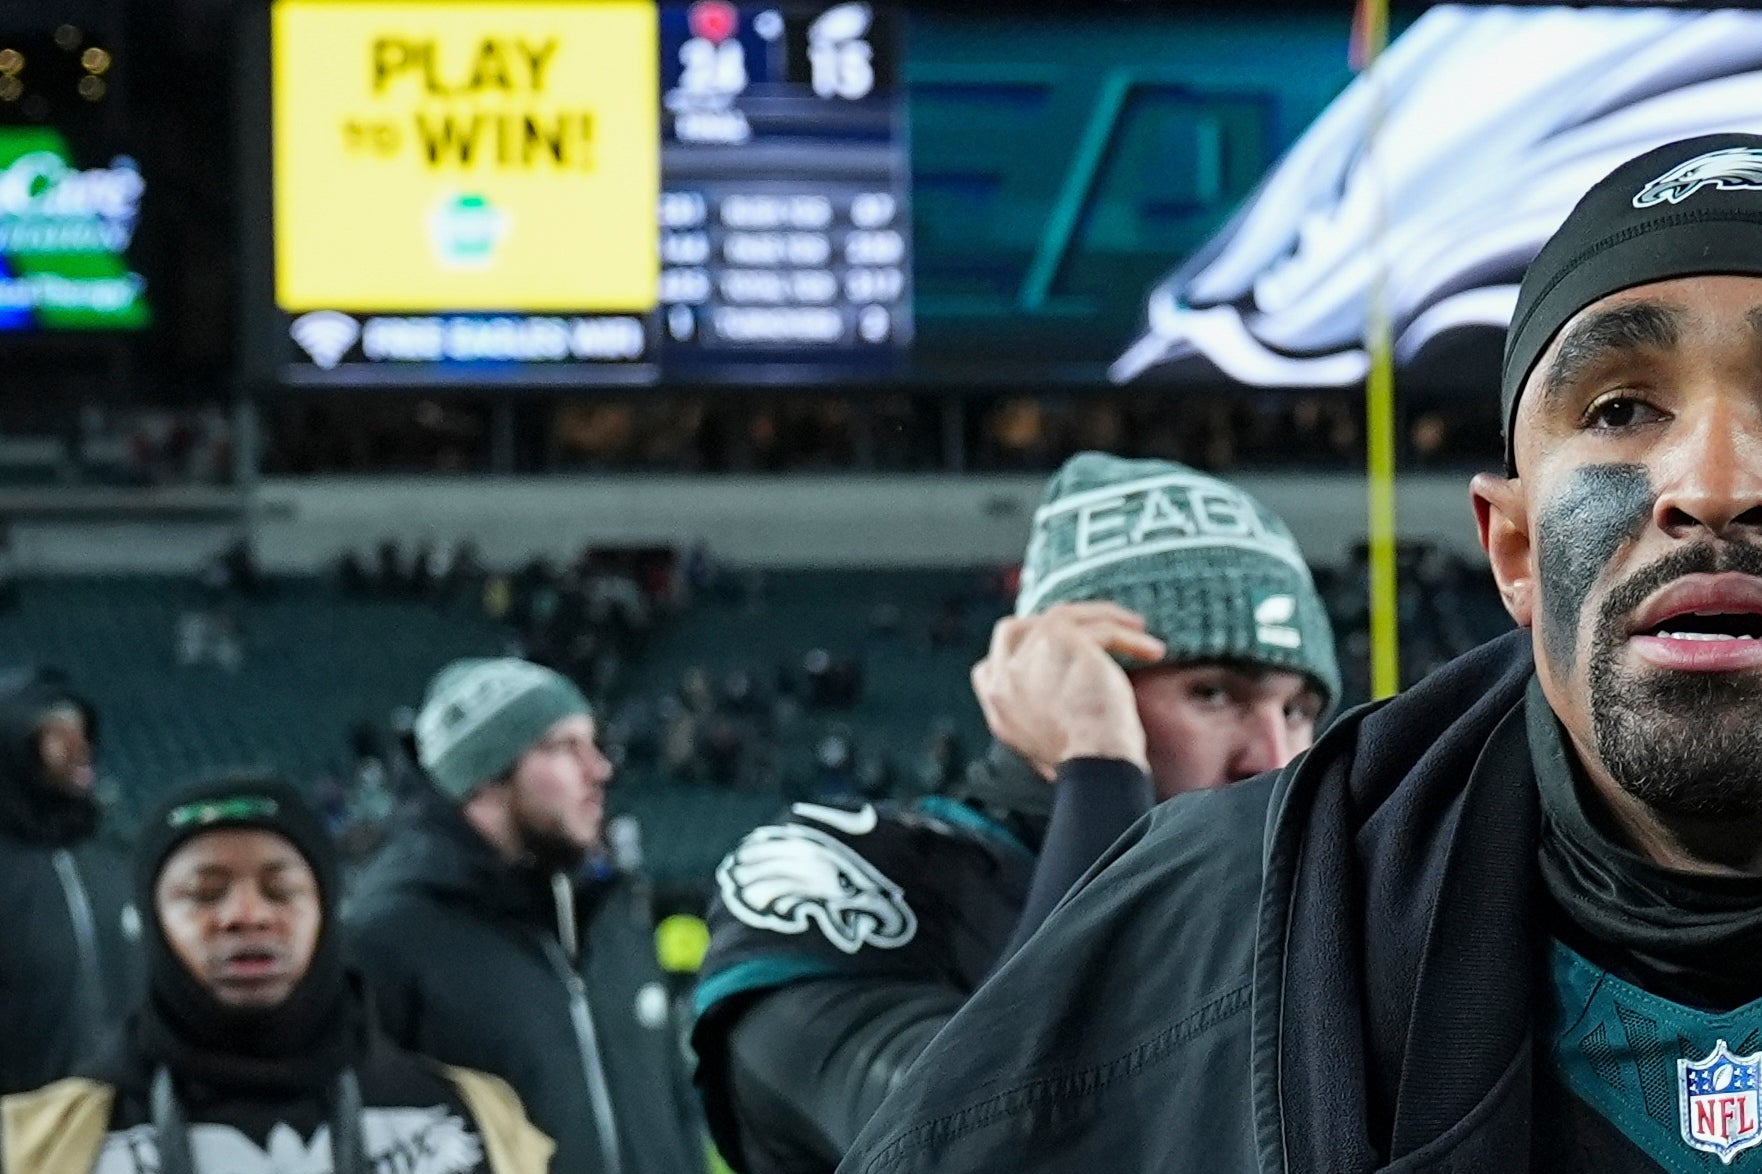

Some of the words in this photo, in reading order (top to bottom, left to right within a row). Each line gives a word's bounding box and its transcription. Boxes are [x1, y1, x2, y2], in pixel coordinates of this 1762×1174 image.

[371, 36, 560, 95] PLAY
[416, 111, 596, 171] WIN!
[1693, 1096, 1754, 1140] NFL
